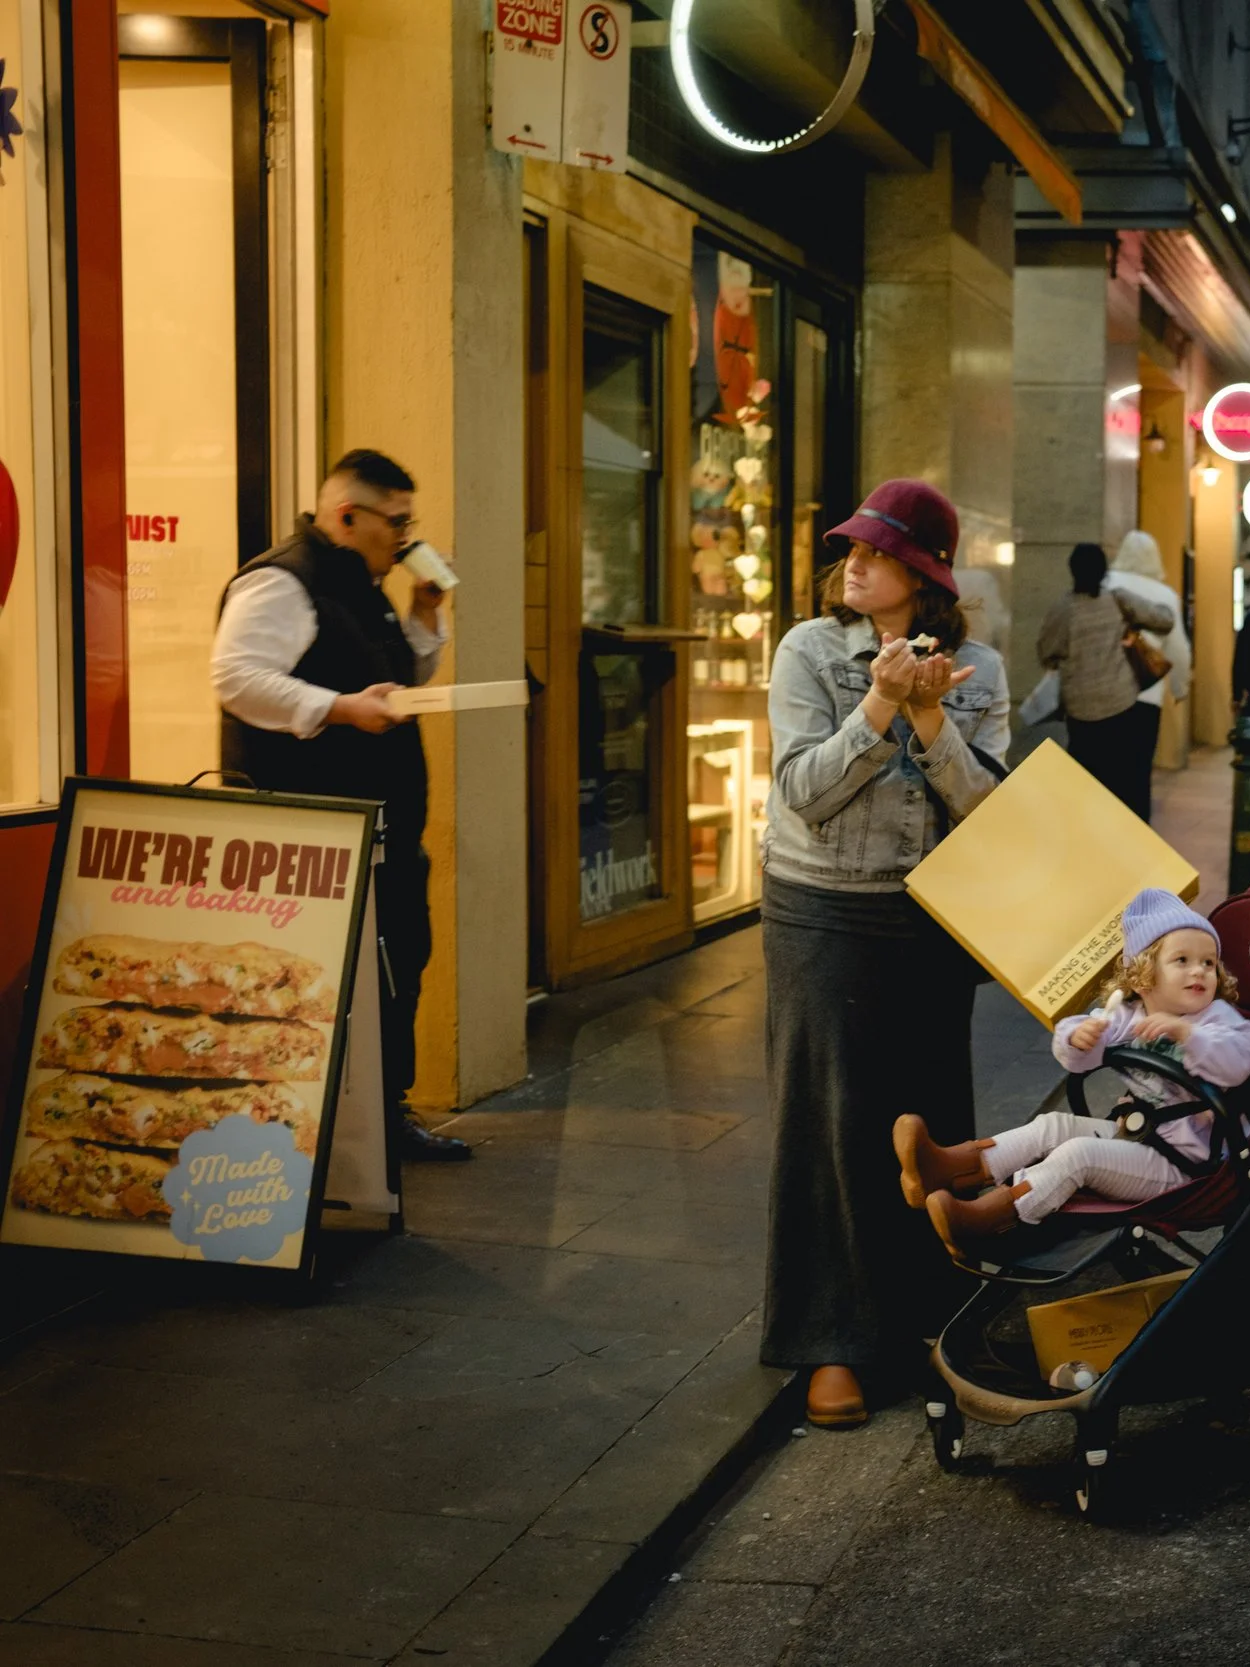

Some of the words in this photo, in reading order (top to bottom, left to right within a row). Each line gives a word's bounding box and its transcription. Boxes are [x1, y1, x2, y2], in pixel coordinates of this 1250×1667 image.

[498, 0, 562, 16] ADING
[502, 7, 557, 38] ZONE
[77, 826, 214, 889] WE'RE
[220, 838, 352, 900] OPEN!
[111, 881, 184, 906] and
[186, 881, 303, 929] baking
[1038, 957, 1080, 997] MAKING
[1077, 937, 1101, 958] THE
[1047, 996, 1058, 1005] A
[1055, 962, 1091, 997] LITTLE
[1089, 932, 1122, 964] MORE
[189, 1150, 285, 1185] Made
[227, 1175, 294, 1207] with
[194, 1203, 274, 1234] Love
